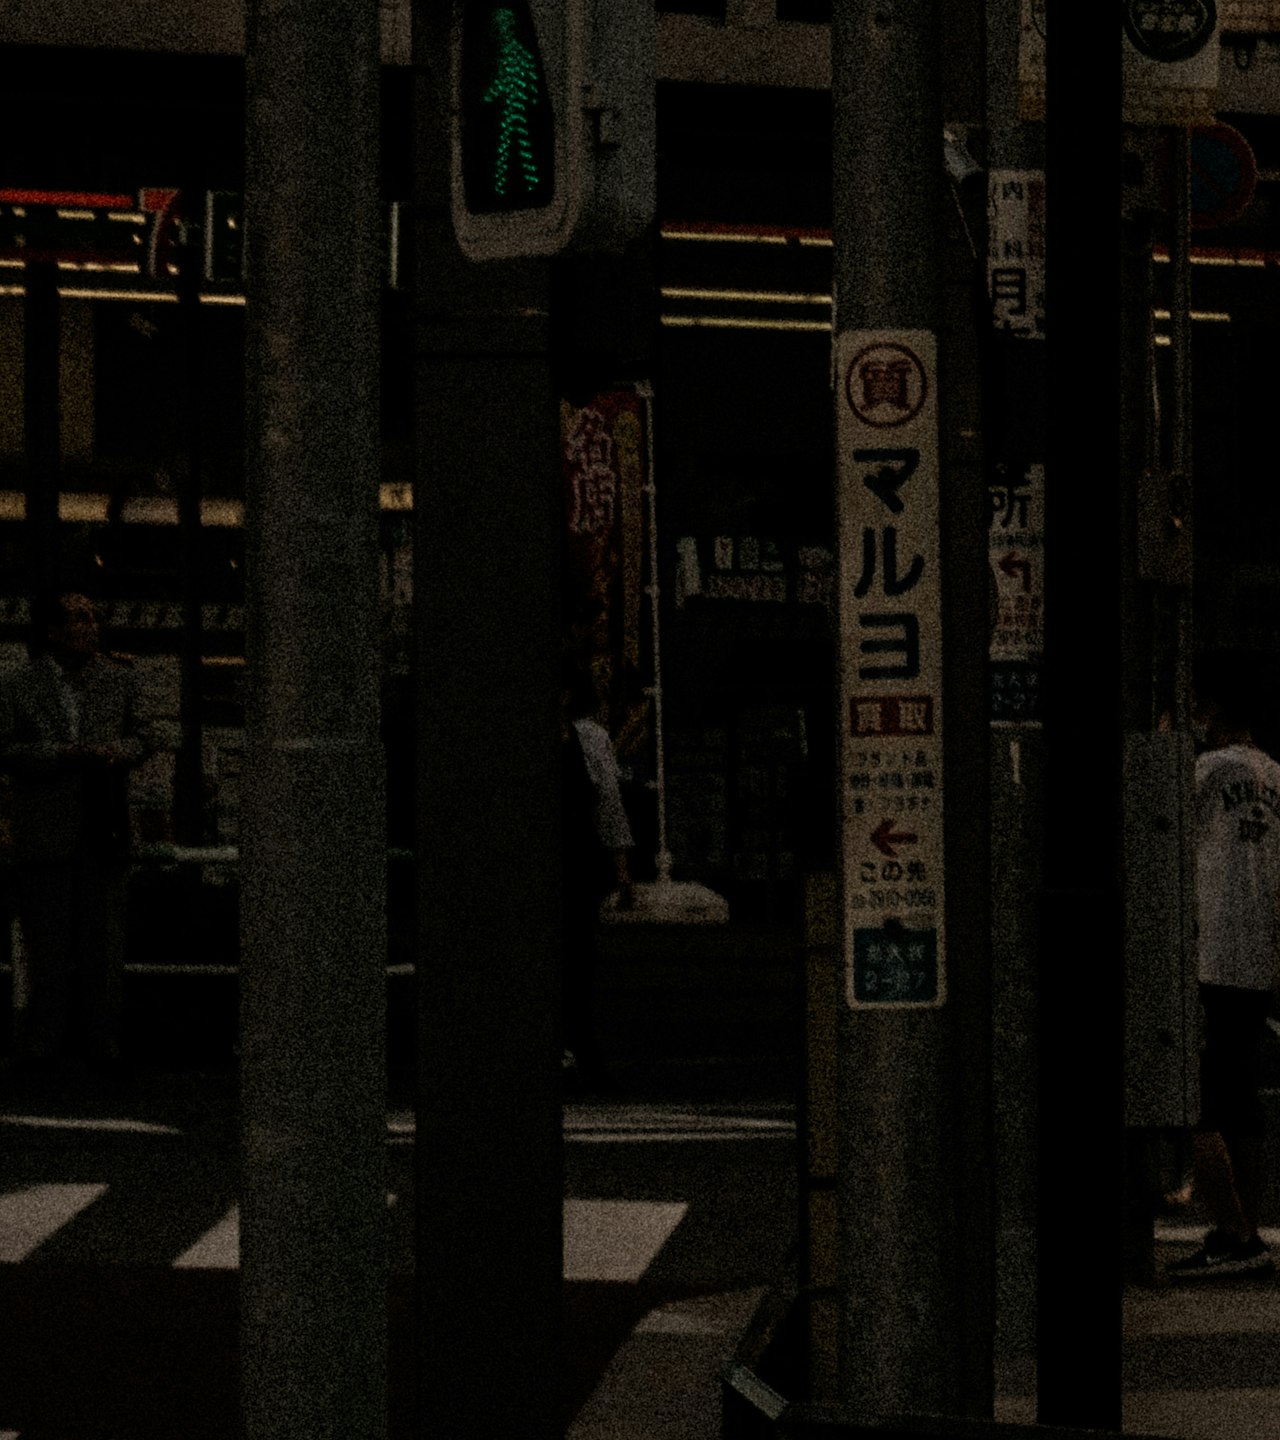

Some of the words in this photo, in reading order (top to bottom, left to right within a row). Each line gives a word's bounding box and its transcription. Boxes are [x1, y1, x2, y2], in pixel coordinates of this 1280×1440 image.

[860, 359, 912, 411] 質
[852, 447, 925, 680] マルヨ
[854, 699, 929, 734] 買取
[860, 861, 927, 883] この先
